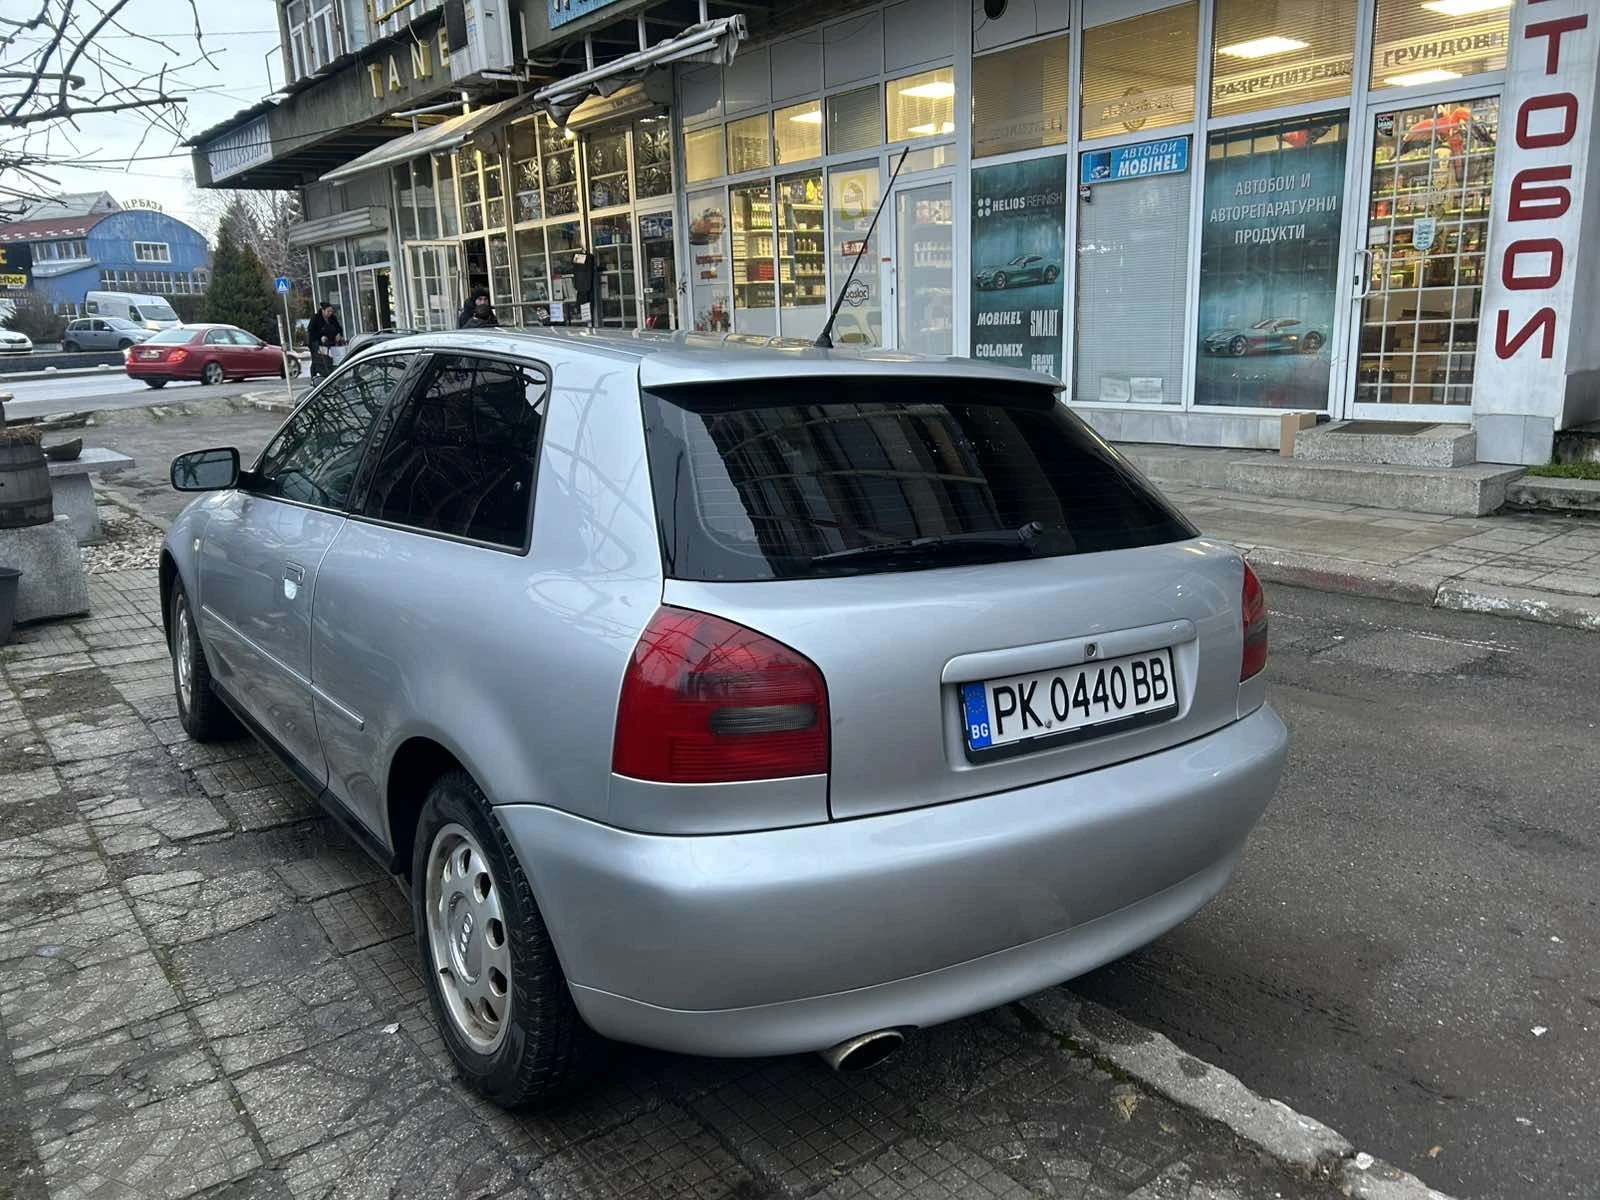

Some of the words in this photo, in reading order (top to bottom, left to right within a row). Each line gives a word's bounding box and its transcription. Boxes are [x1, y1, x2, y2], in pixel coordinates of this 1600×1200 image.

[1120, 142, 1177, 160] АВТОБОИ
[1118, 153, 1178, 177] MOBIHEL
[1235, 175, 1295, 196] АВТОБОИ
[1301, 172, 1311, 188] И
[1495, 0, 1588, 360] ТОБОИ
[992, 197, 1025, 212] HELIOS
[1027, 192, 1063, 207] REFINISH
[1210, 195, 1337, 223] АВТОРЕПАРАТУРНИ
[1234, 223, 1305, 245] ПРОДУКТИ
[976, 311, 1022, 326] MOBIHEL
[1030, 310, 1059, 337] SMART
[976, 343, 1023, 357] COLOMIX
[992, 680, 1044, 736] PK
[1050, 665, 1127, 722] 0440
[1131, 657, 1169, 706] BB
[971, 723, 989, 740] BG
